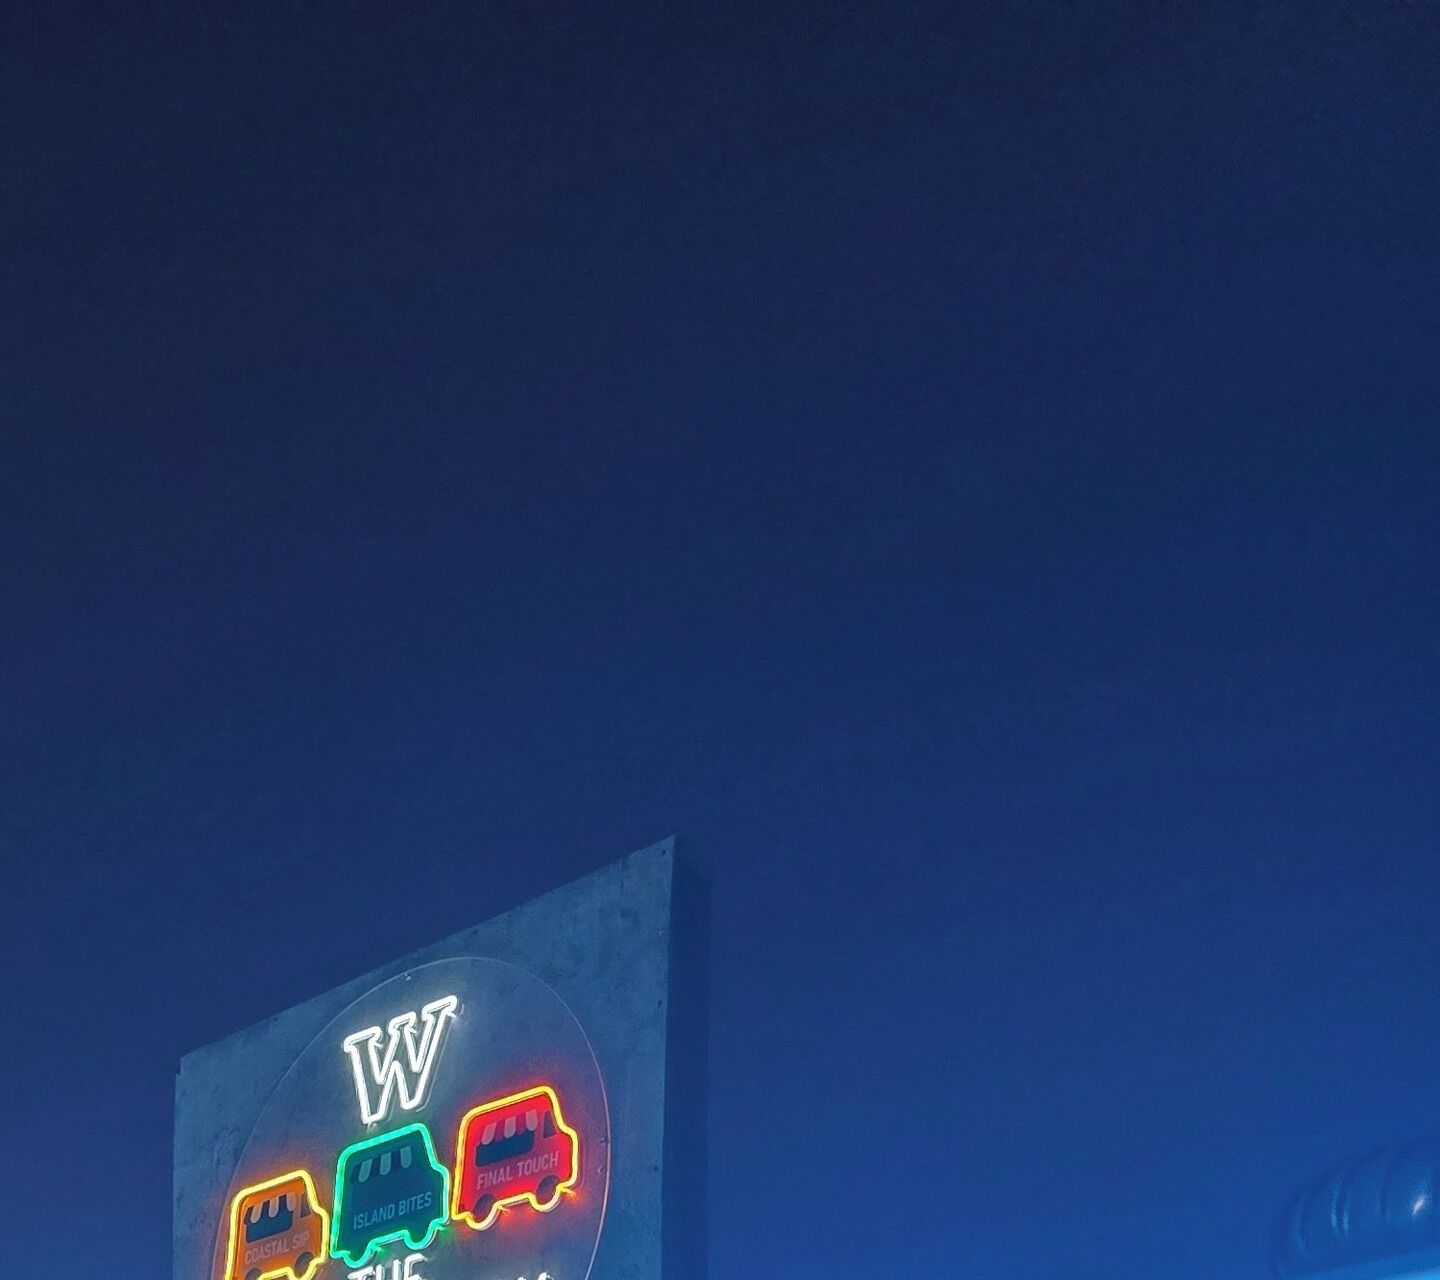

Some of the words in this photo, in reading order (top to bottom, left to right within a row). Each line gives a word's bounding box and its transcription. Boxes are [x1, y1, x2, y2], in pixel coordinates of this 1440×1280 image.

[343, 995, 457, 1124] W
[476, 1169, 514, 1191] FINAL
[517, 1151, 559, 1179] TOUCH
[353, 1203, 395, 1231] ISLAND
[398, 1191, 432, 1216] BITES
[244, 1239, 290, 1265] COASTAL
[292, 1231, 311, 1251] SIP
